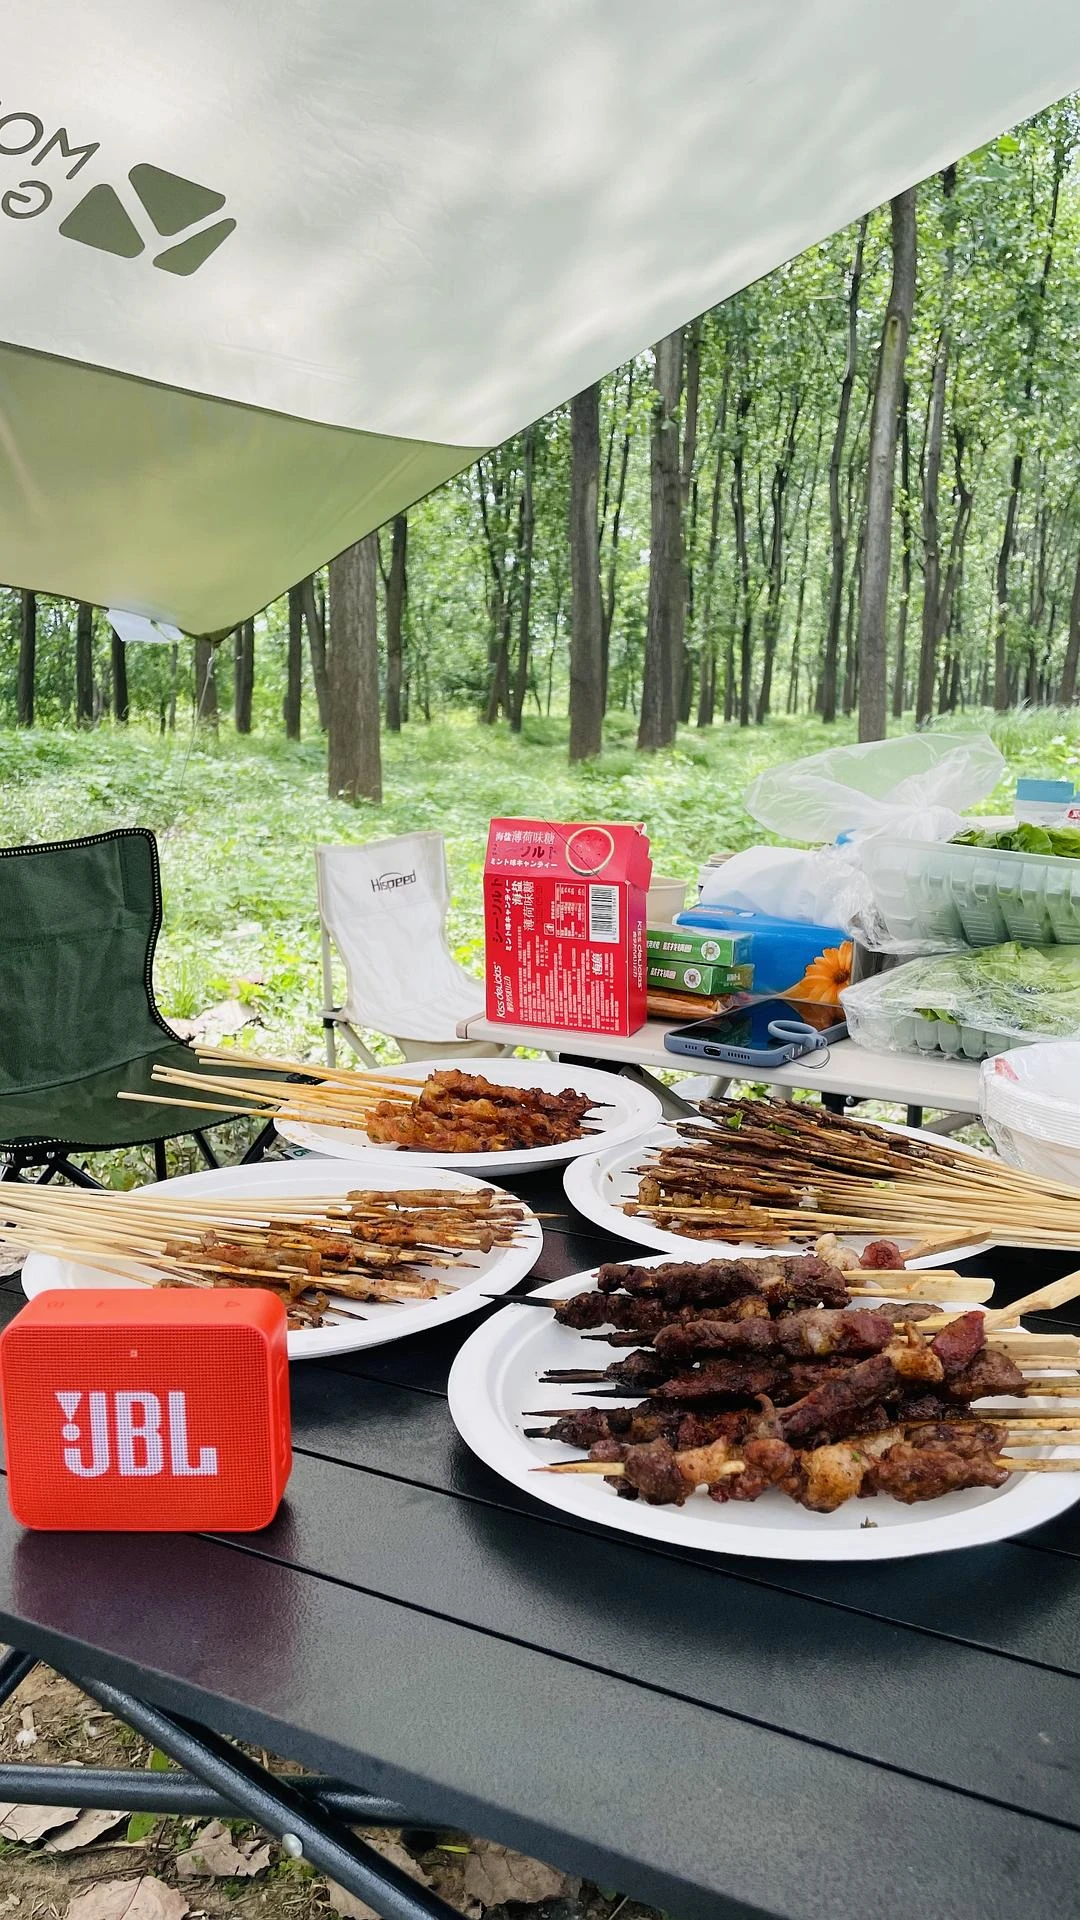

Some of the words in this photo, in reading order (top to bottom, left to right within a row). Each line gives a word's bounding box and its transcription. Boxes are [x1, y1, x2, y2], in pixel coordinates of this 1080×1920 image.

[495, 830, 555, 845] 海盐薄荷味糖
[523, 881, 534, 930] 薄荷味糖
[60, 1391, 218, 1477] JBL
